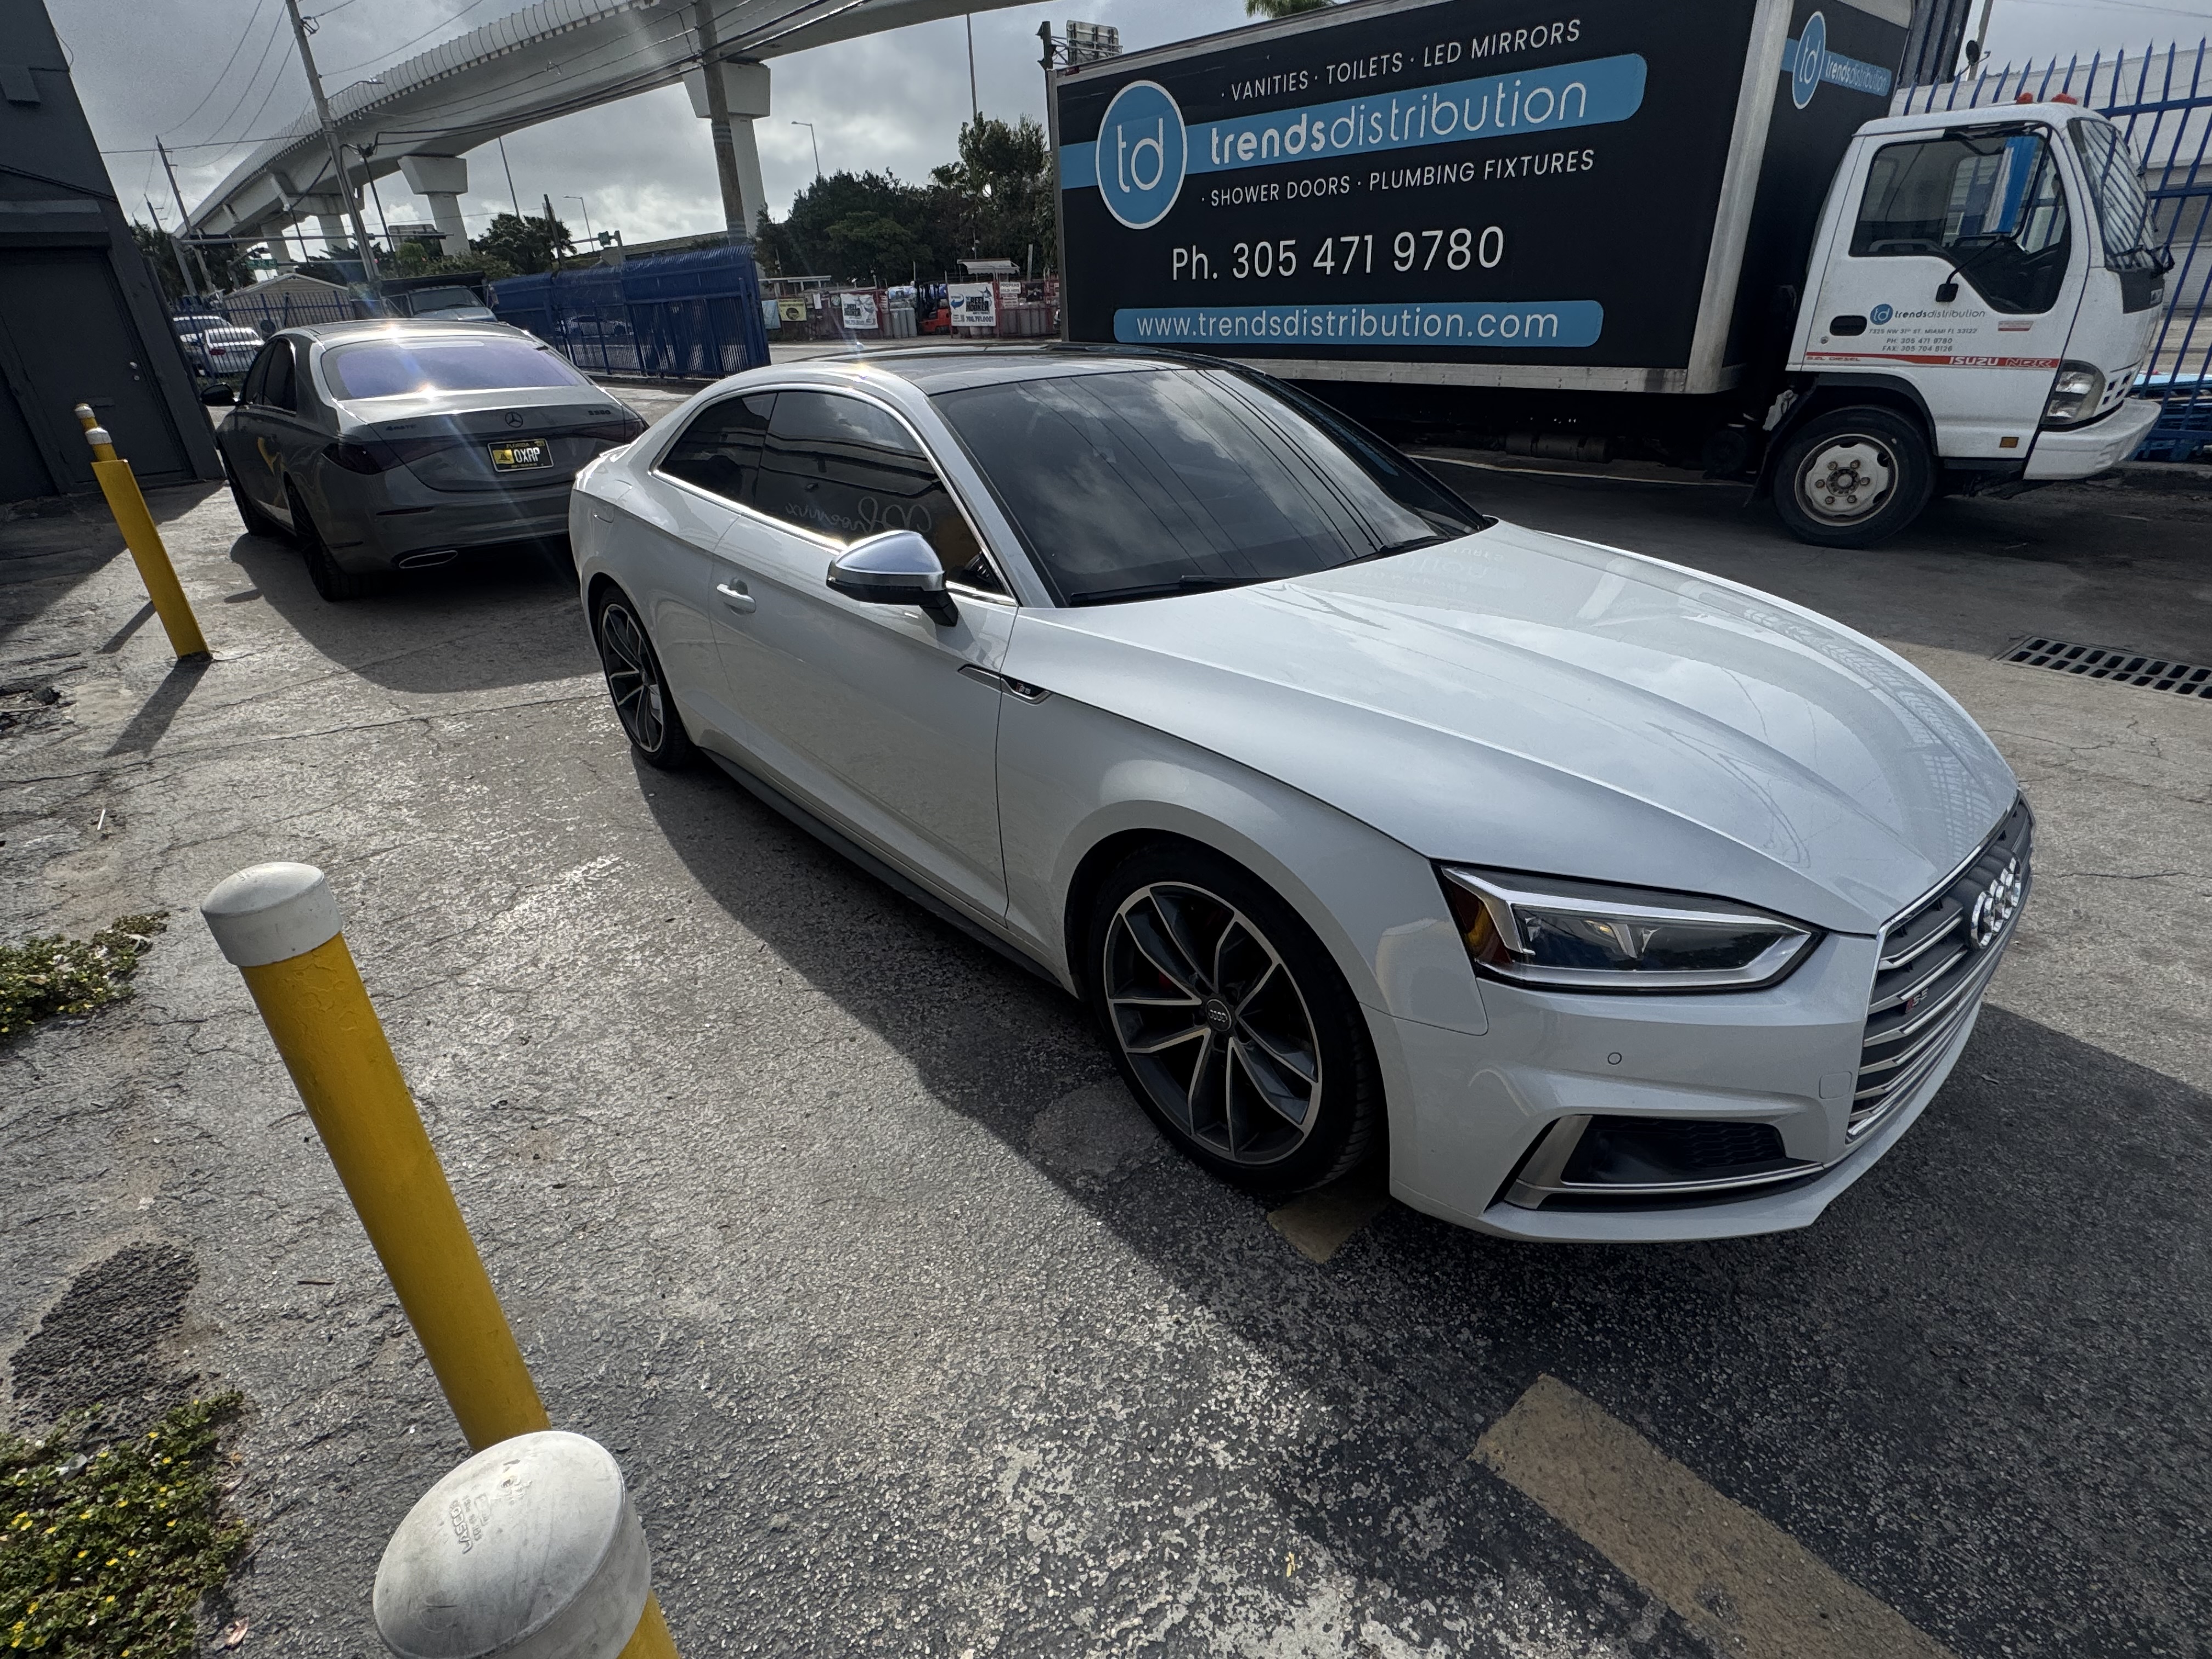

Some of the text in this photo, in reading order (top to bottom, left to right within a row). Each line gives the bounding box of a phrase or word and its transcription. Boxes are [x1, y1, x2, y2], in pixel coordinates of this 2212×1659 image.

[1231, 19, 1581, 101] VANITIES TOILETS LED MIRRORS
[1799, 35, 1821, 84] td
[1211, 80, 1587, 165] trendsdistribution
[1117, 117, 1164, 193] td
[1211, 149, 1594, 206] SHOWER DOORS PLUMBING FIXTURES
[1173, 225, 1504, 280] Ph. 305 471 9780
[1137, 307, 1558, 338] www.trendsdistribution.com
[1873, 307, 1891, 321] td
[1894, 309, 1986, 319] trendsdistribution
[1949, 356, 1999, 366] ISUZU
